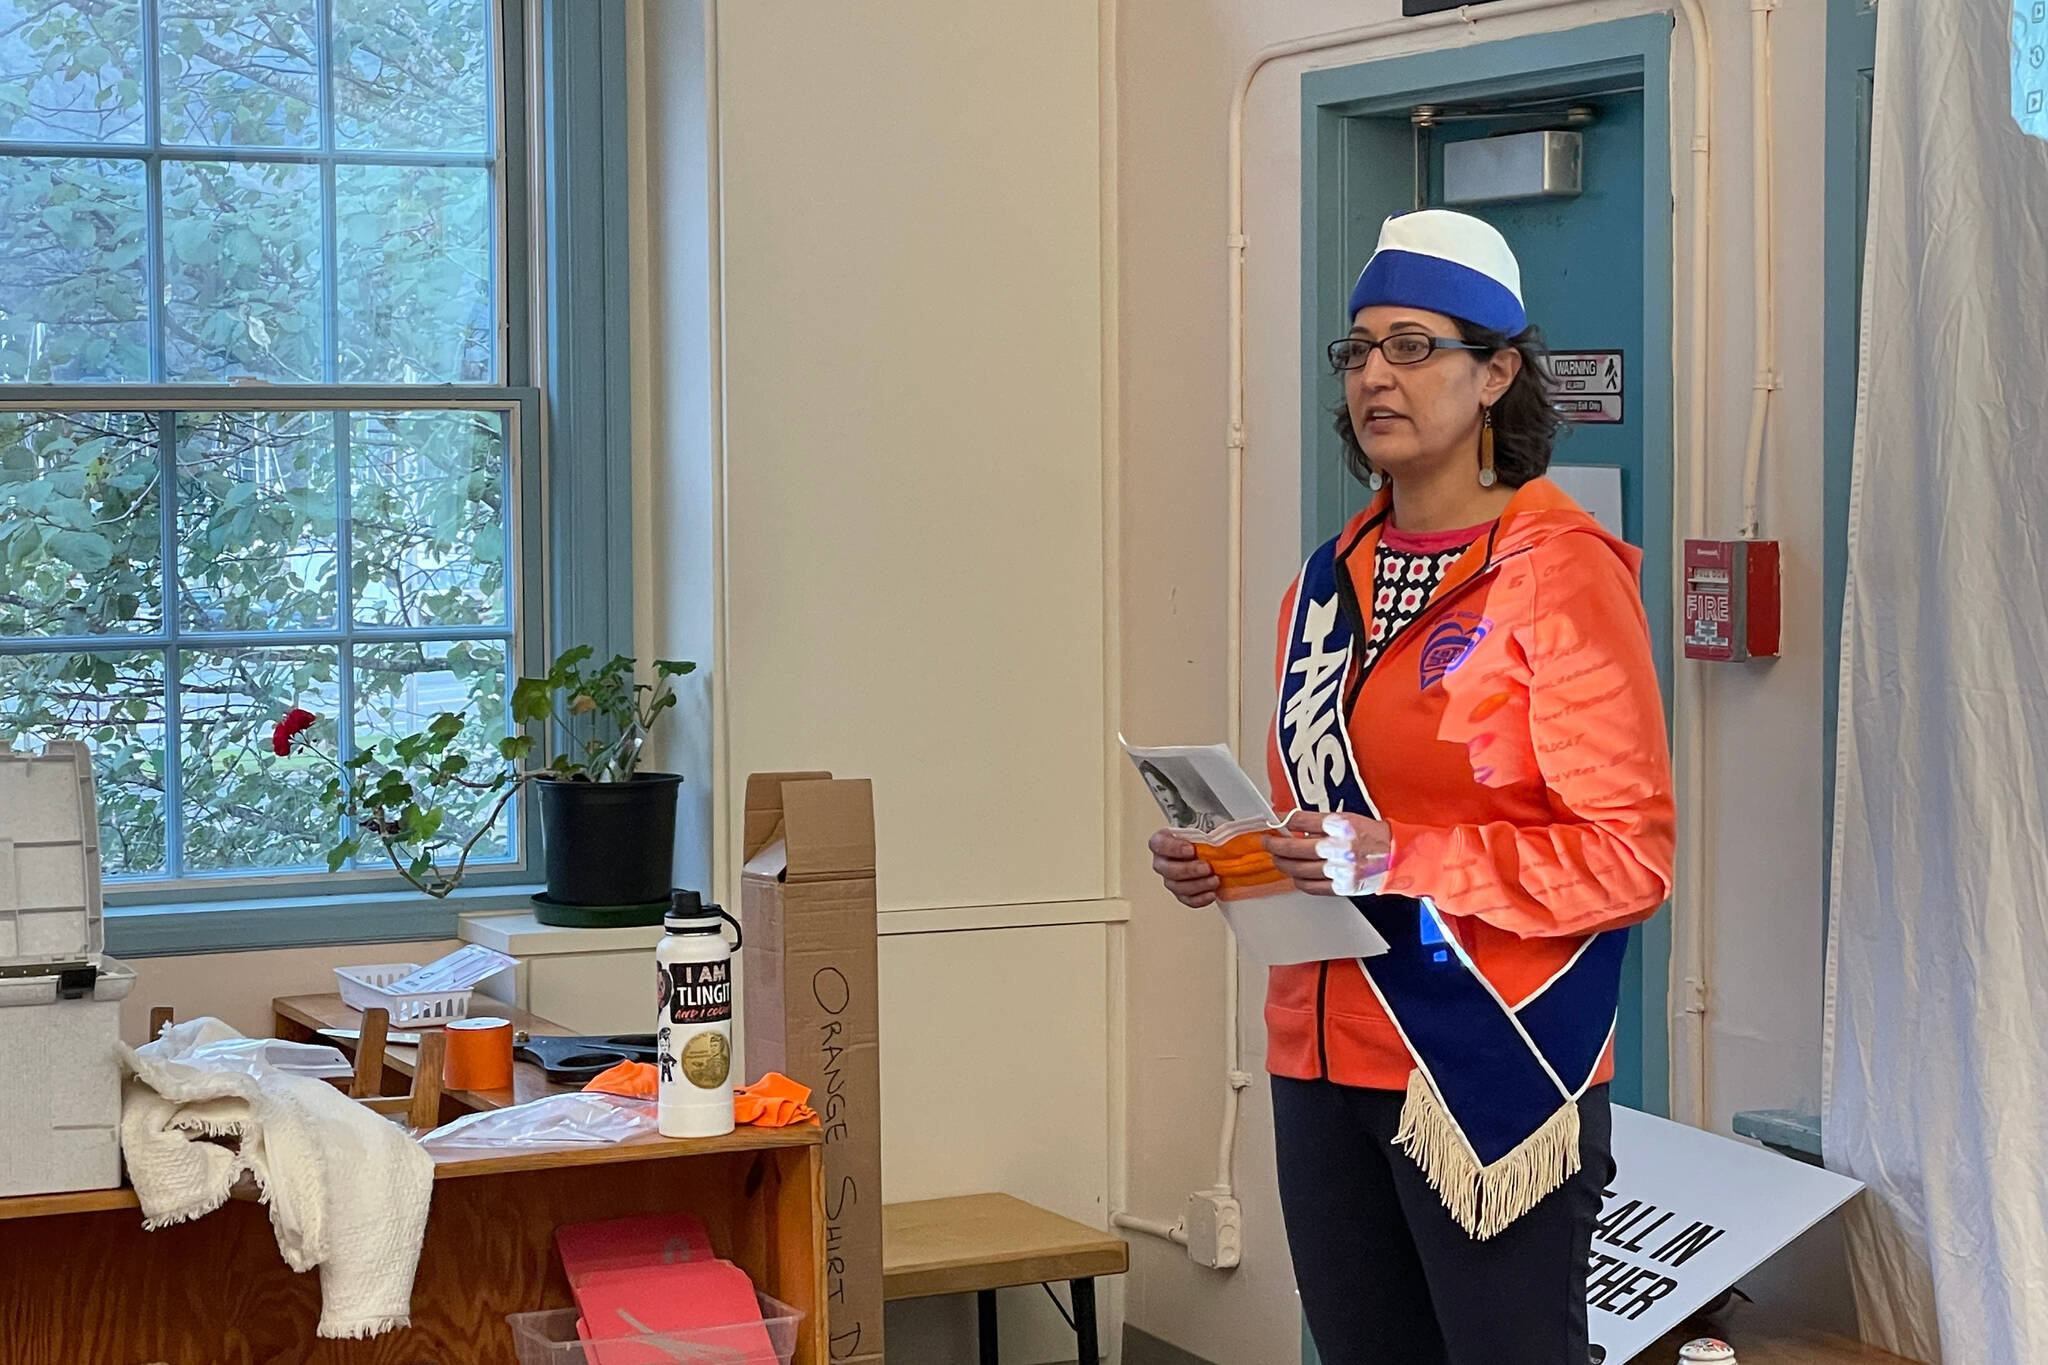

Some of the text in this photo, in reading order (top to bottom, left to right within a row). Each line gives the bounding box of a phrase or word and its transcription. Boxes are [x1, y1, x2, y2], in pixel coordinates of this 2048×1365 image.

[1556, 361, 1596, 375] WARNING
[1687, 595, 1729, 622] FIRE
[686, 964, 726, 984] I AM
[676, 982, 730, 1006] TLINGIT
[675, 1009, 698, 1019] AND
[700, 1009, 705, 1018] I
[812, 966, 861, 1362] ORANGE SHIRT D
[1593, 1200, 1726, 1267] ALL IN
[1586, 1250, 1678, 1320] THER
